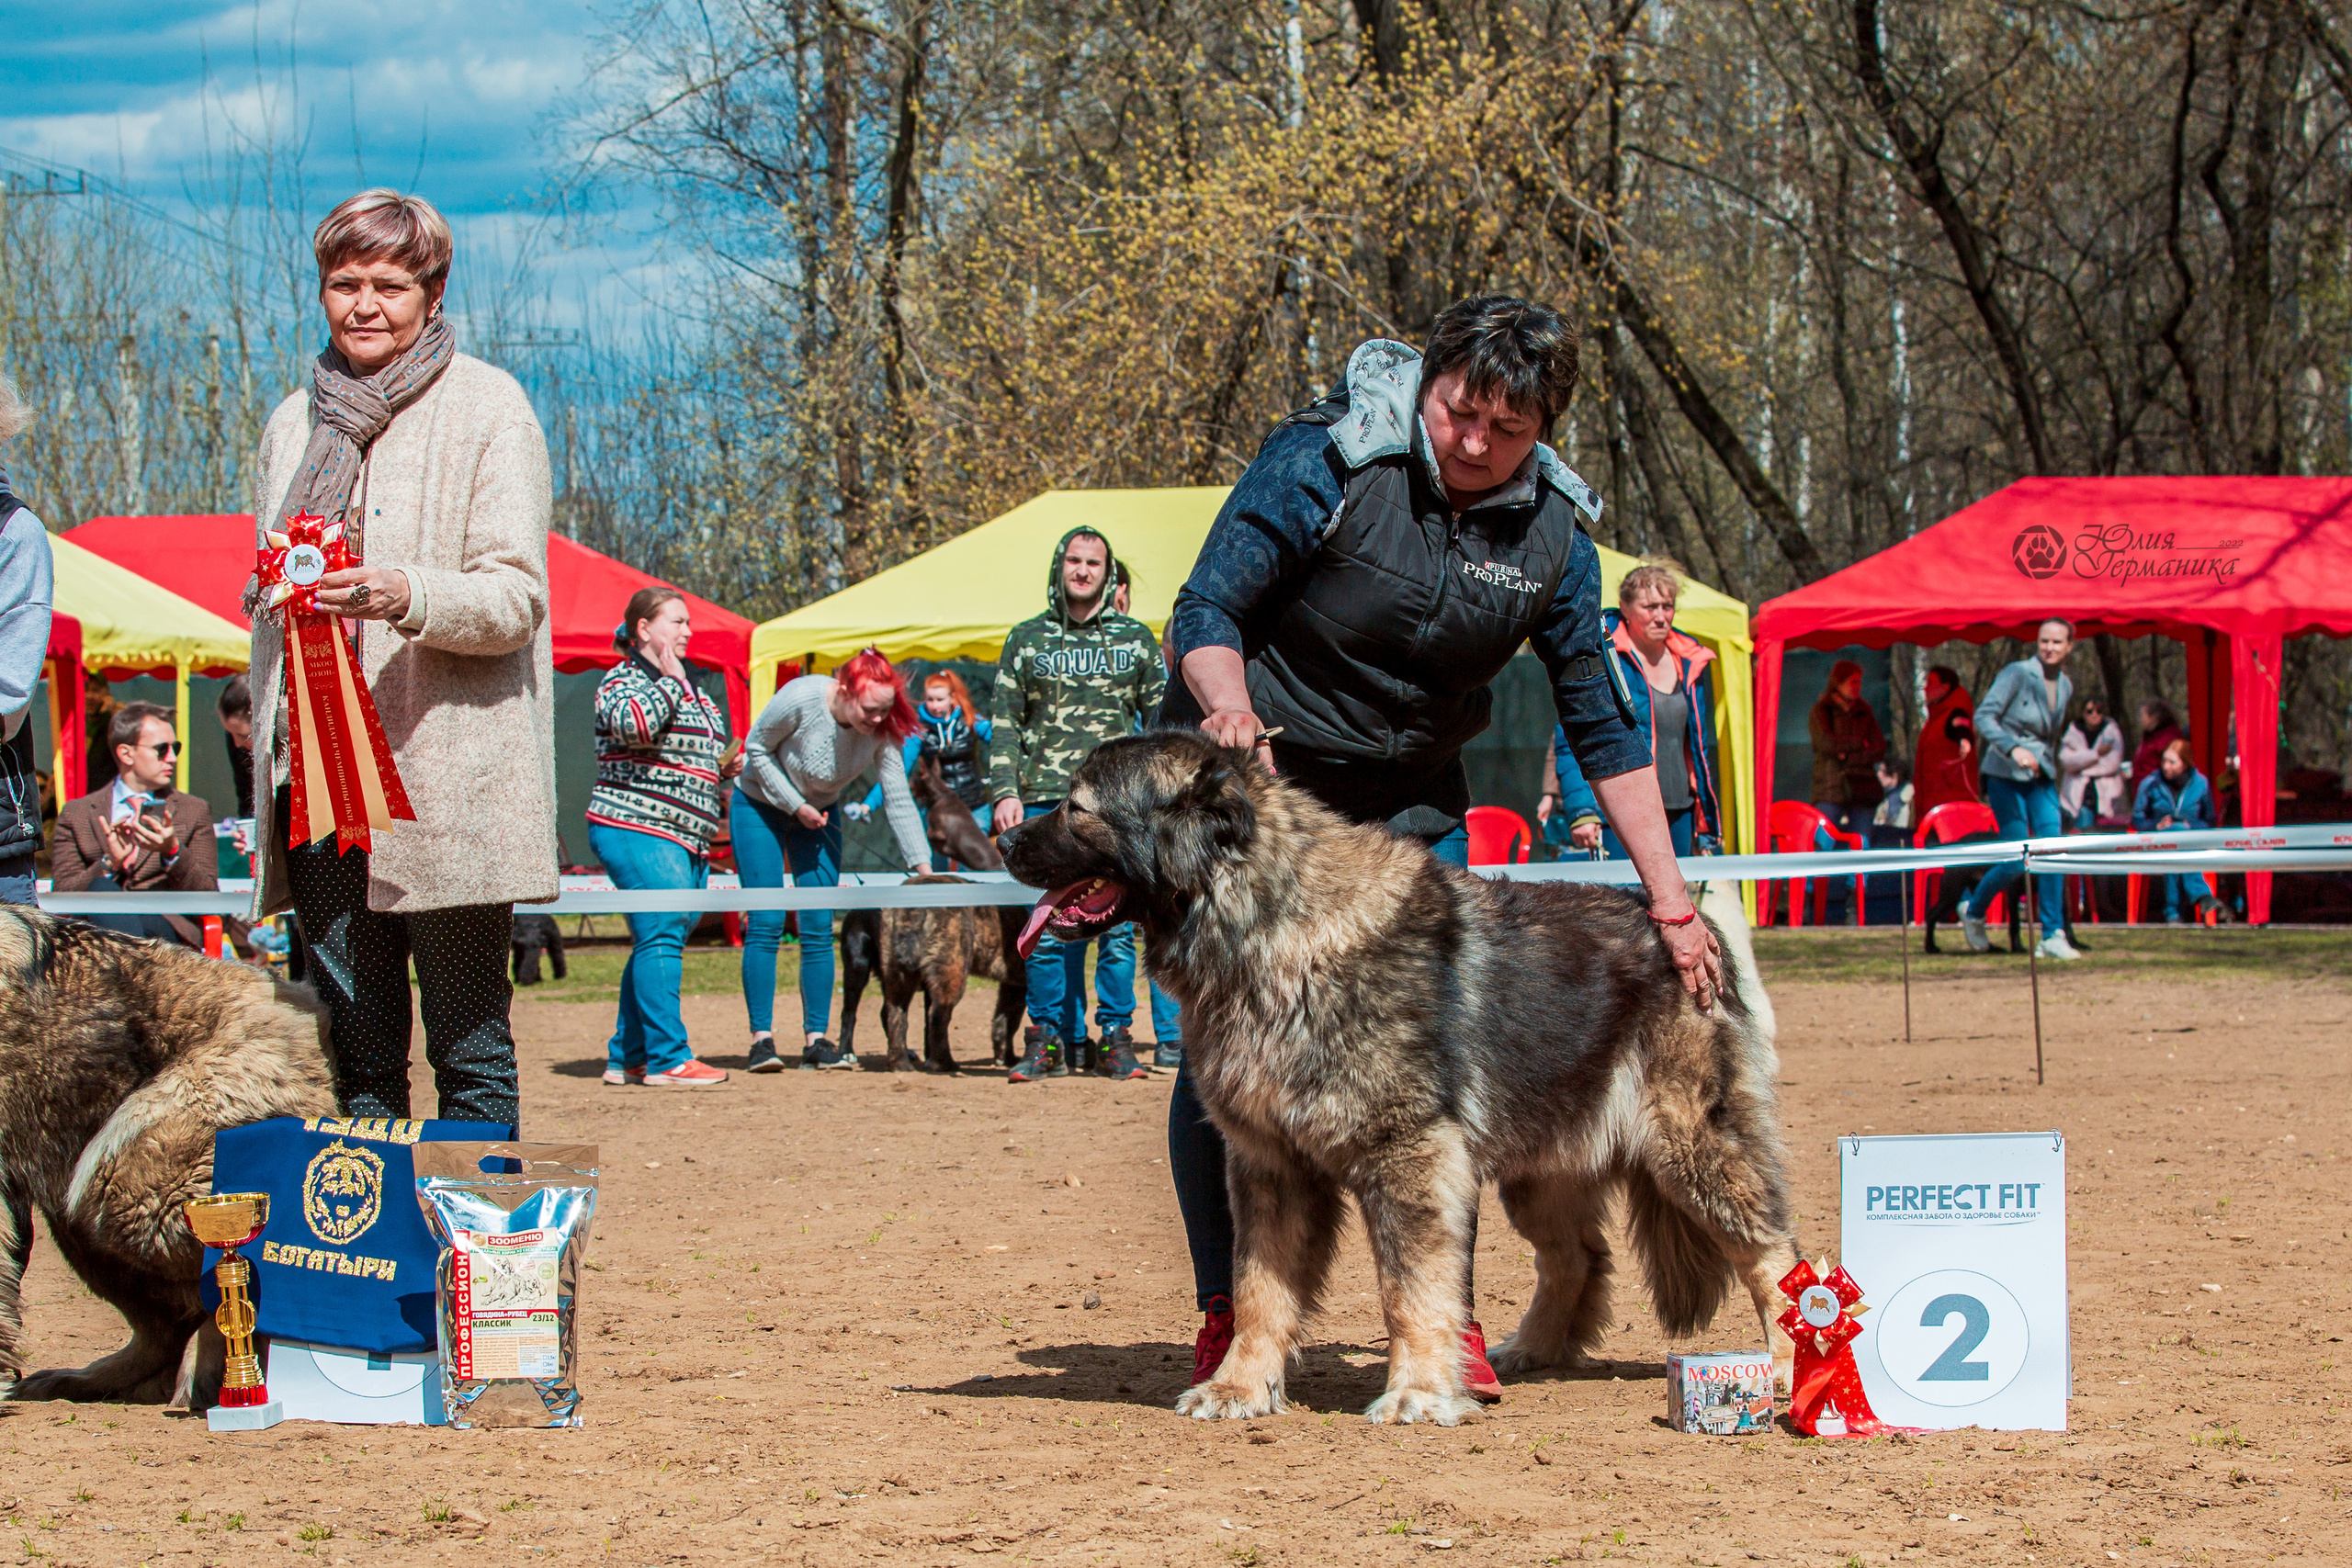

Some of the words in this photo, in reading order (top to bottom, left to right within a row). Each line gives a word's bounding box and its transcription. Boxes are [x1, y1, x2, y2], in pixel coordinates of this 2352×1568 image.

[1033, 648, 1133, 679] SQUAD
[322, 695, 337, 741] КАНДИДАТ
[334, 750, 349, 801] ЧЕМПИОНЫ
[1866, 1184, 1991, 1211] PERFECT
[1999, 1183, 2041, 1209] FIT
[1962, 1212, 2002, 1220] ЗДОРОВЬЕ
[490, 1233, 542, 1245] ЗООМЕНЮ
[262, 1240, 398, 1281] БОГАТЫРИ
[457, 1232, 471, 1377] ПРОФЕССИОН
[472, 1320, 512, 1328] КЛАССИК
[1917, 1293, 1990, 1382] 2
[1687, 1363, 1773, 1382] MOSCOW
